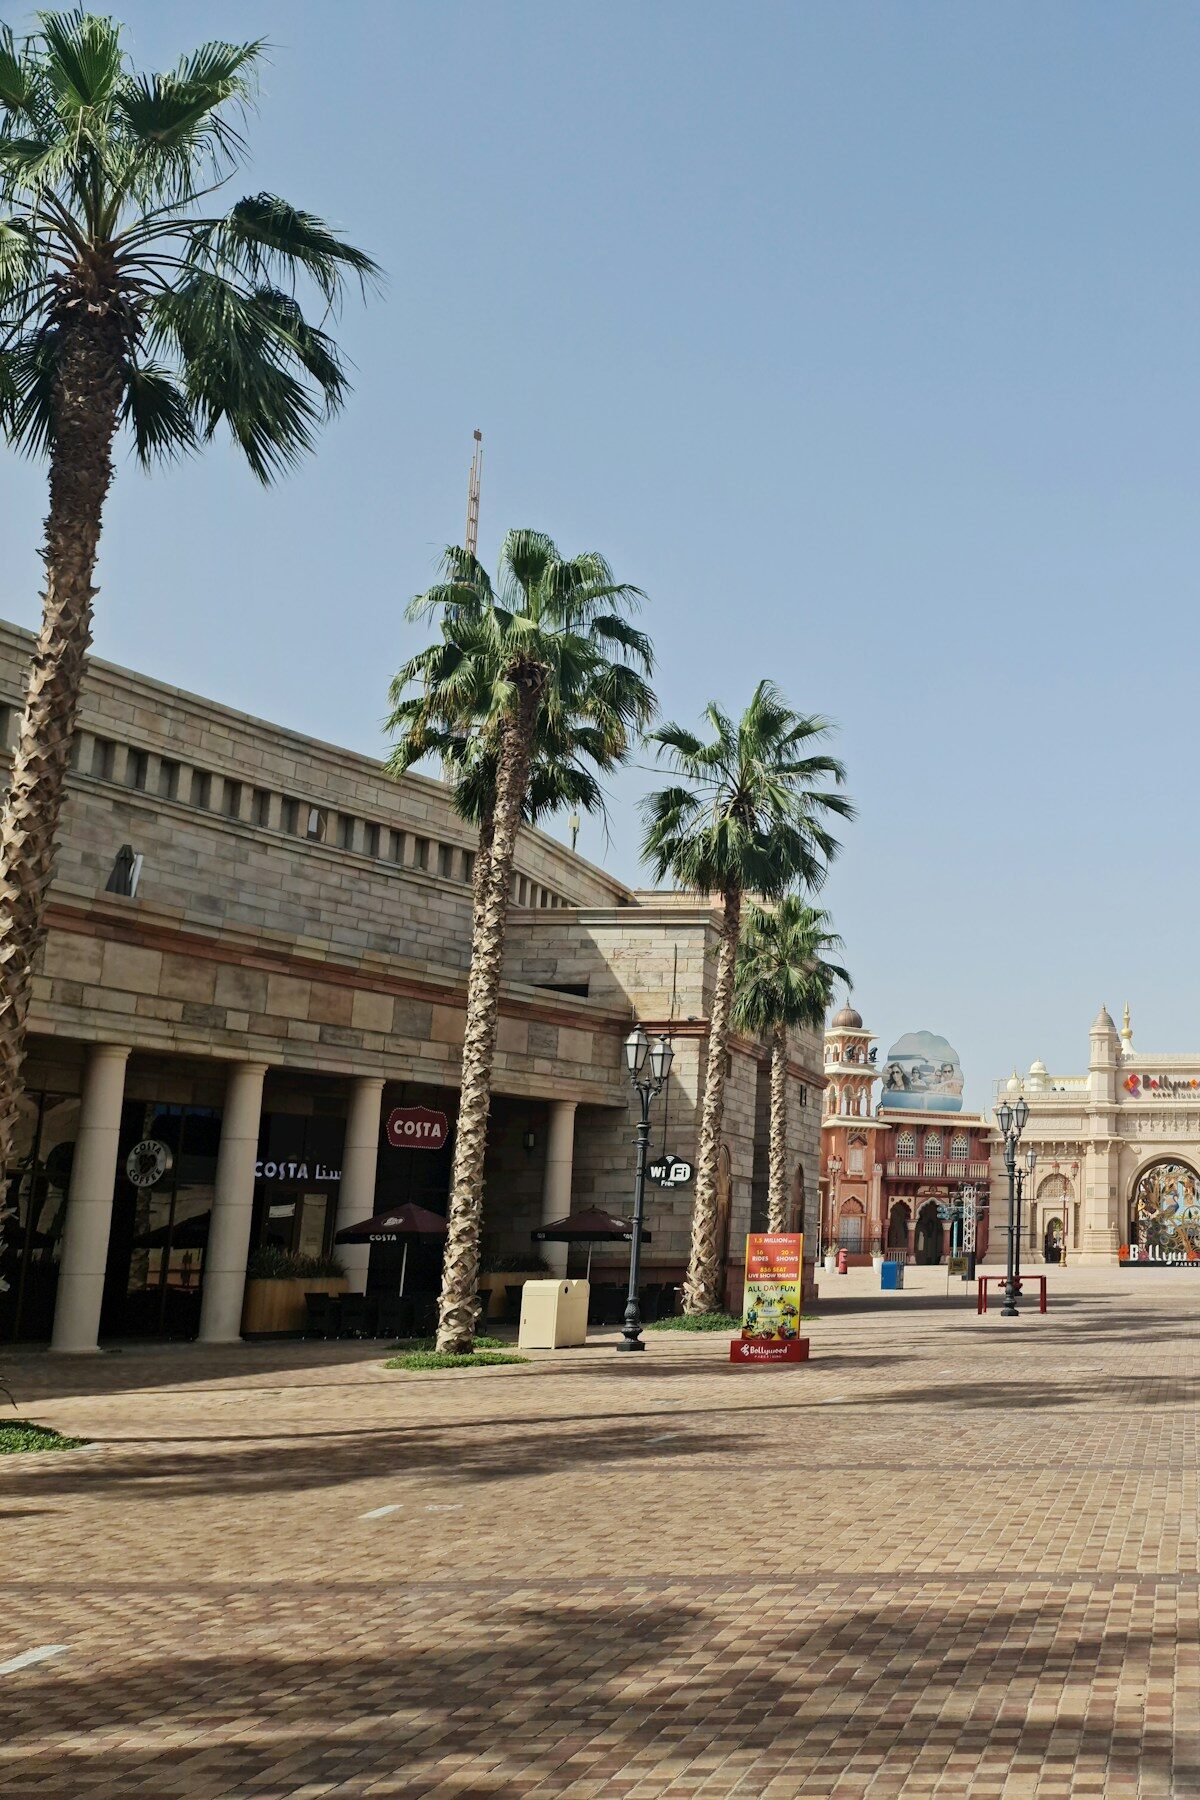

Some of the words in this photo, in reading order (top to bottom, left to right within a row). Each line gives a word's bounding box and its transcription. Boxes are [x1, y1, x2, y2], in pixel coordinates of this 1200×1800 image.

[394, 1120, 441, 1138] COSTA
[134, 1142, 162, 1155] COSTA
[130, 1169, 162, 1184] COFFEE
[255, 1161, 308, 1180] COSTA
[650, 1166, 666, 1178] Wi
[674, 1167, 687, 1178] Fi
[749, 1346, 788, 1355] Bollywood
